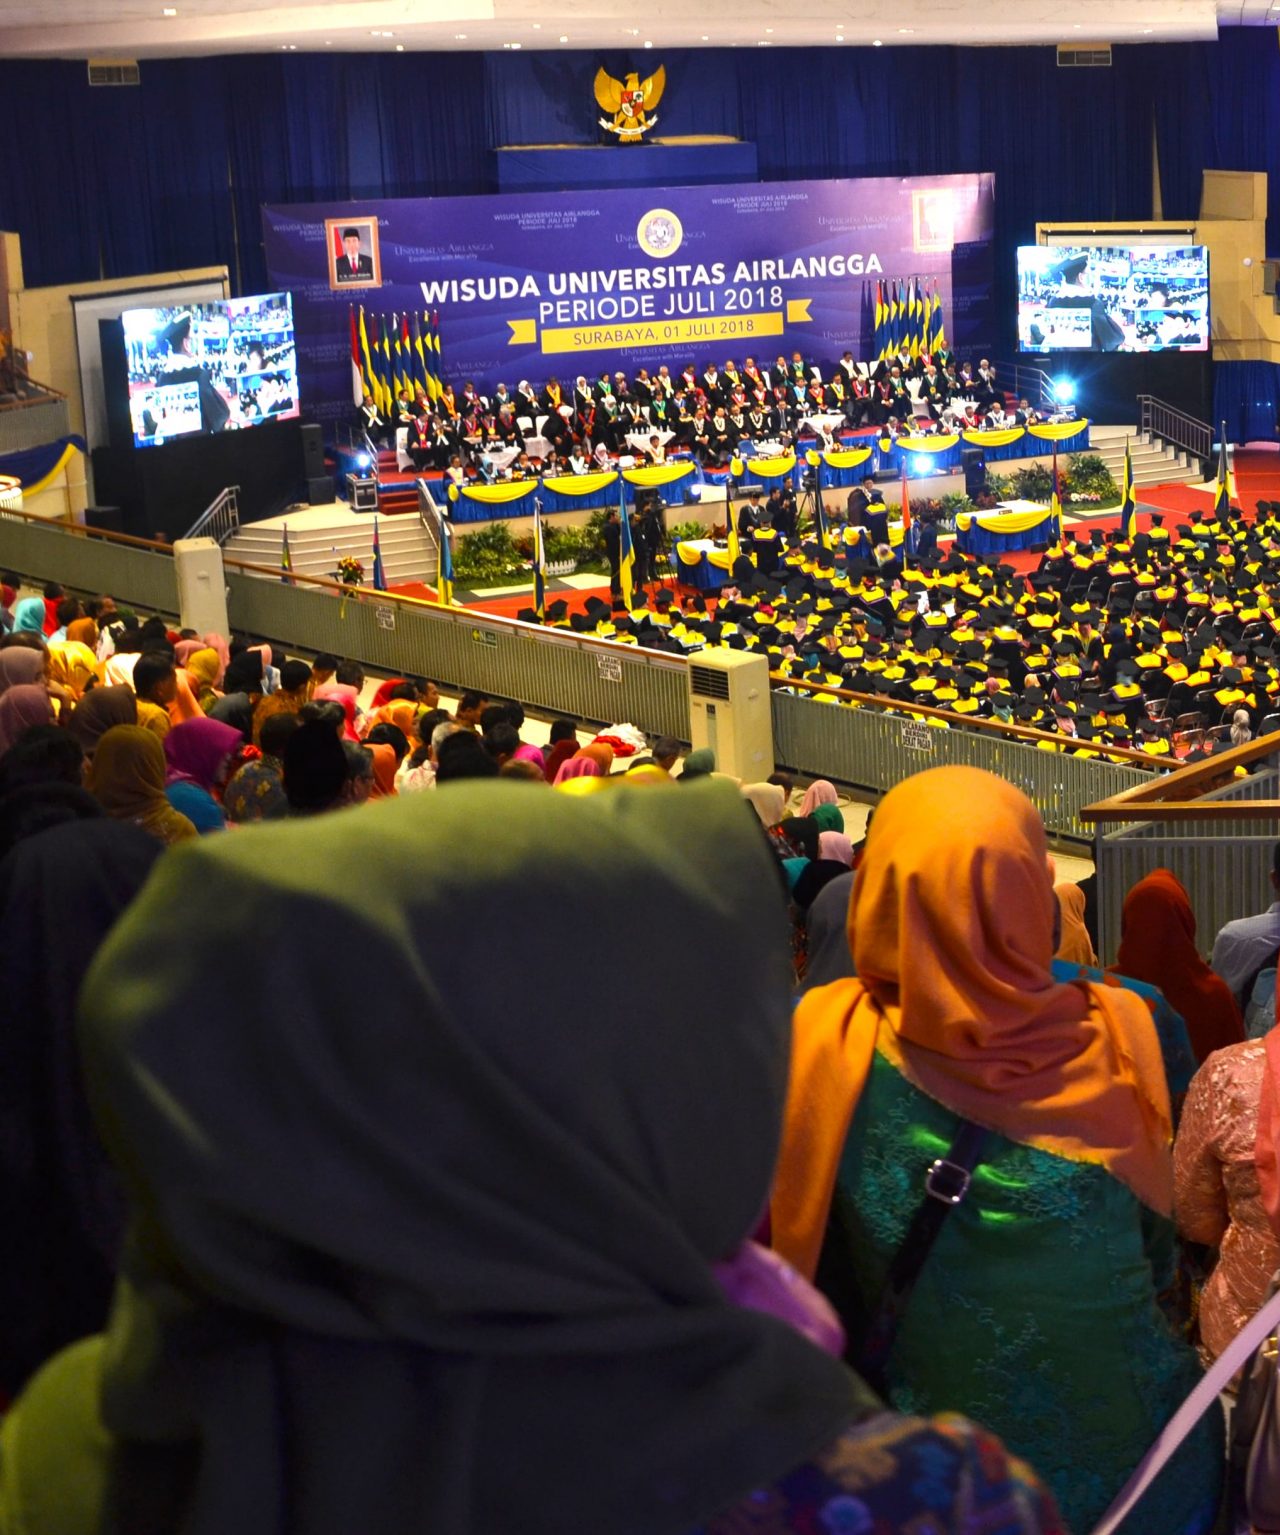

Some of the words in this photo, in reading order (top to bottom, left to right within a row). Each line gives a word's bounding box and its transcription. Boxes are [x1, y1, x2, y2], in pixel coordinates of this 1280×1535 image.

[493, 213, 520, 221] WISUDA
[521, 210, 562, 220] UNIVERSITAS
[563, 209, 600, 217] AIRLANGGA
[420, 275, 541, 304] WISUDA
[548, 262, 726, 296] UNIVERSITAS
[733, 253, 883, 283] AIRLANGGA
[539, 295, 656, 324] PERIODE
[663, 290, 715, 316] JULI
[724, 285, 783, 310] 2018
[573, 327, 660, 346] SURABAYA,
[663, 325, 680, 338] 01
[686, 323, 715, 337] JULI
[720, 319, 755, 334] 2018
